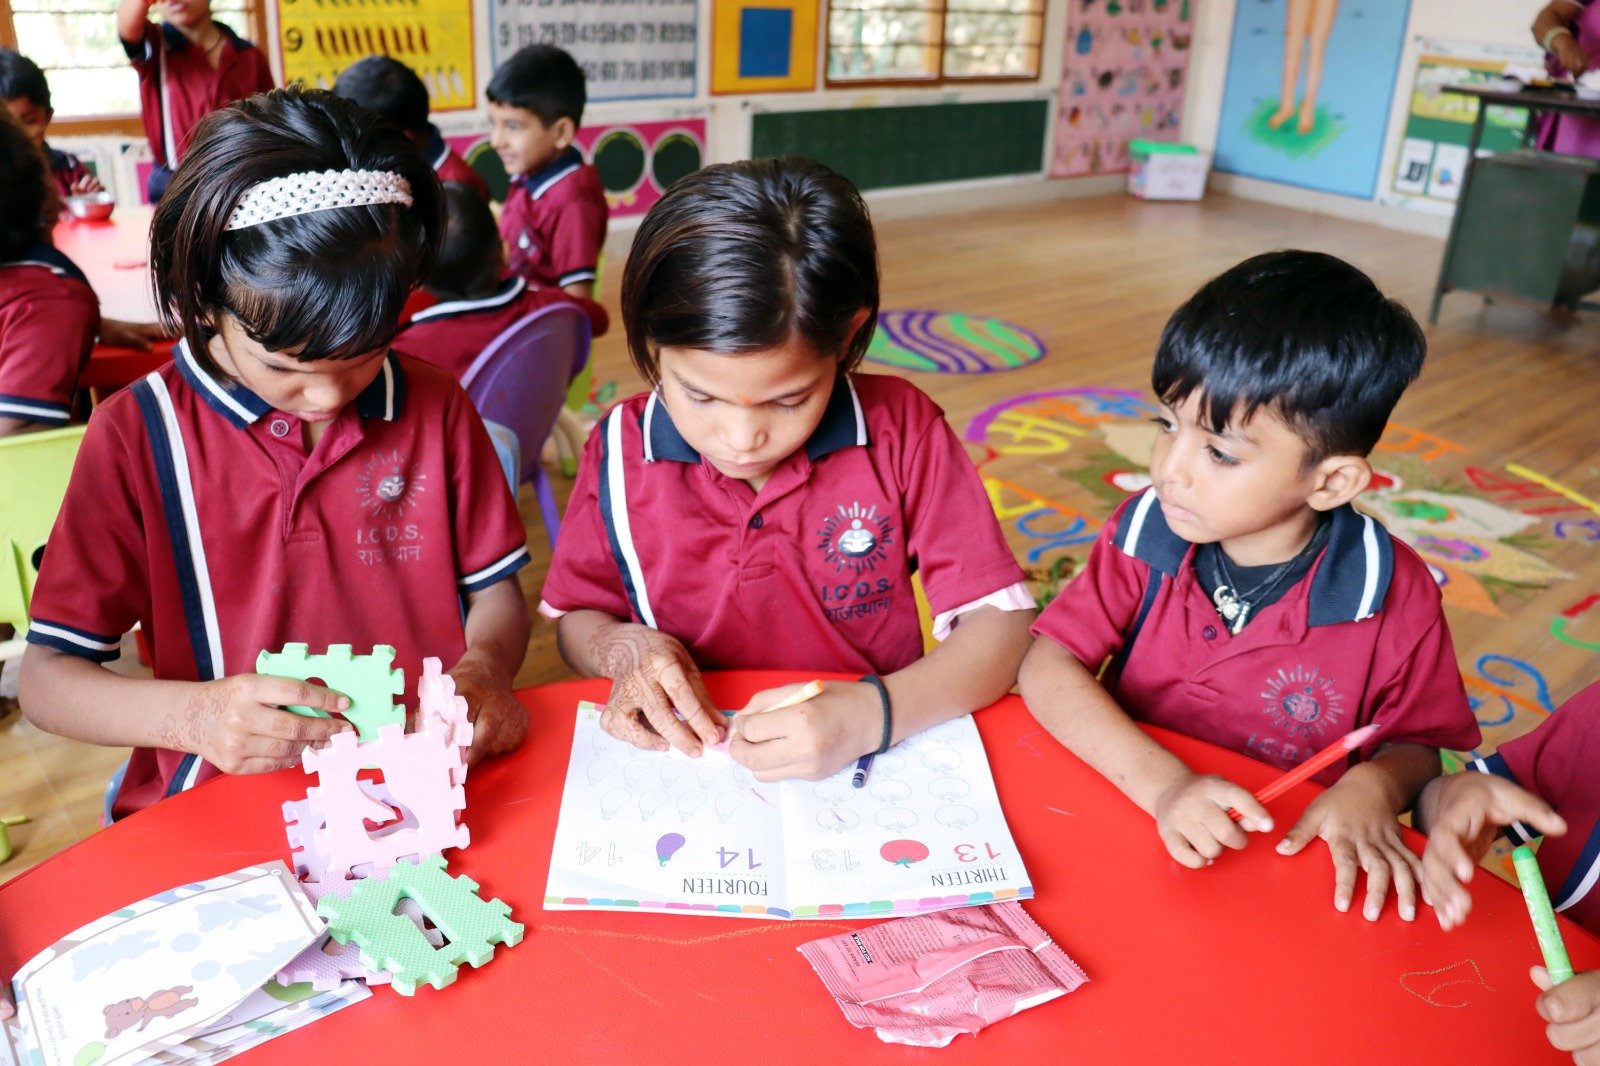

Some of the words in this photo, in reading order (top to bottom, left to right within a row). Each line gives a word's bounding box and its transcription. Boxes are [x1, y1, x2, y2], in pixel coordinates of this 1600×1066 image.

[286, 28, 302, 52] 9
[356, 524, 424, 544] I.CD.S.
[716, 846, 762, 869] 14
[954, 842, 1002, 863] 13
[682, 877, 768, 896] FOURTEEN
[931, 867, 1009, 887] THIRTEEN
